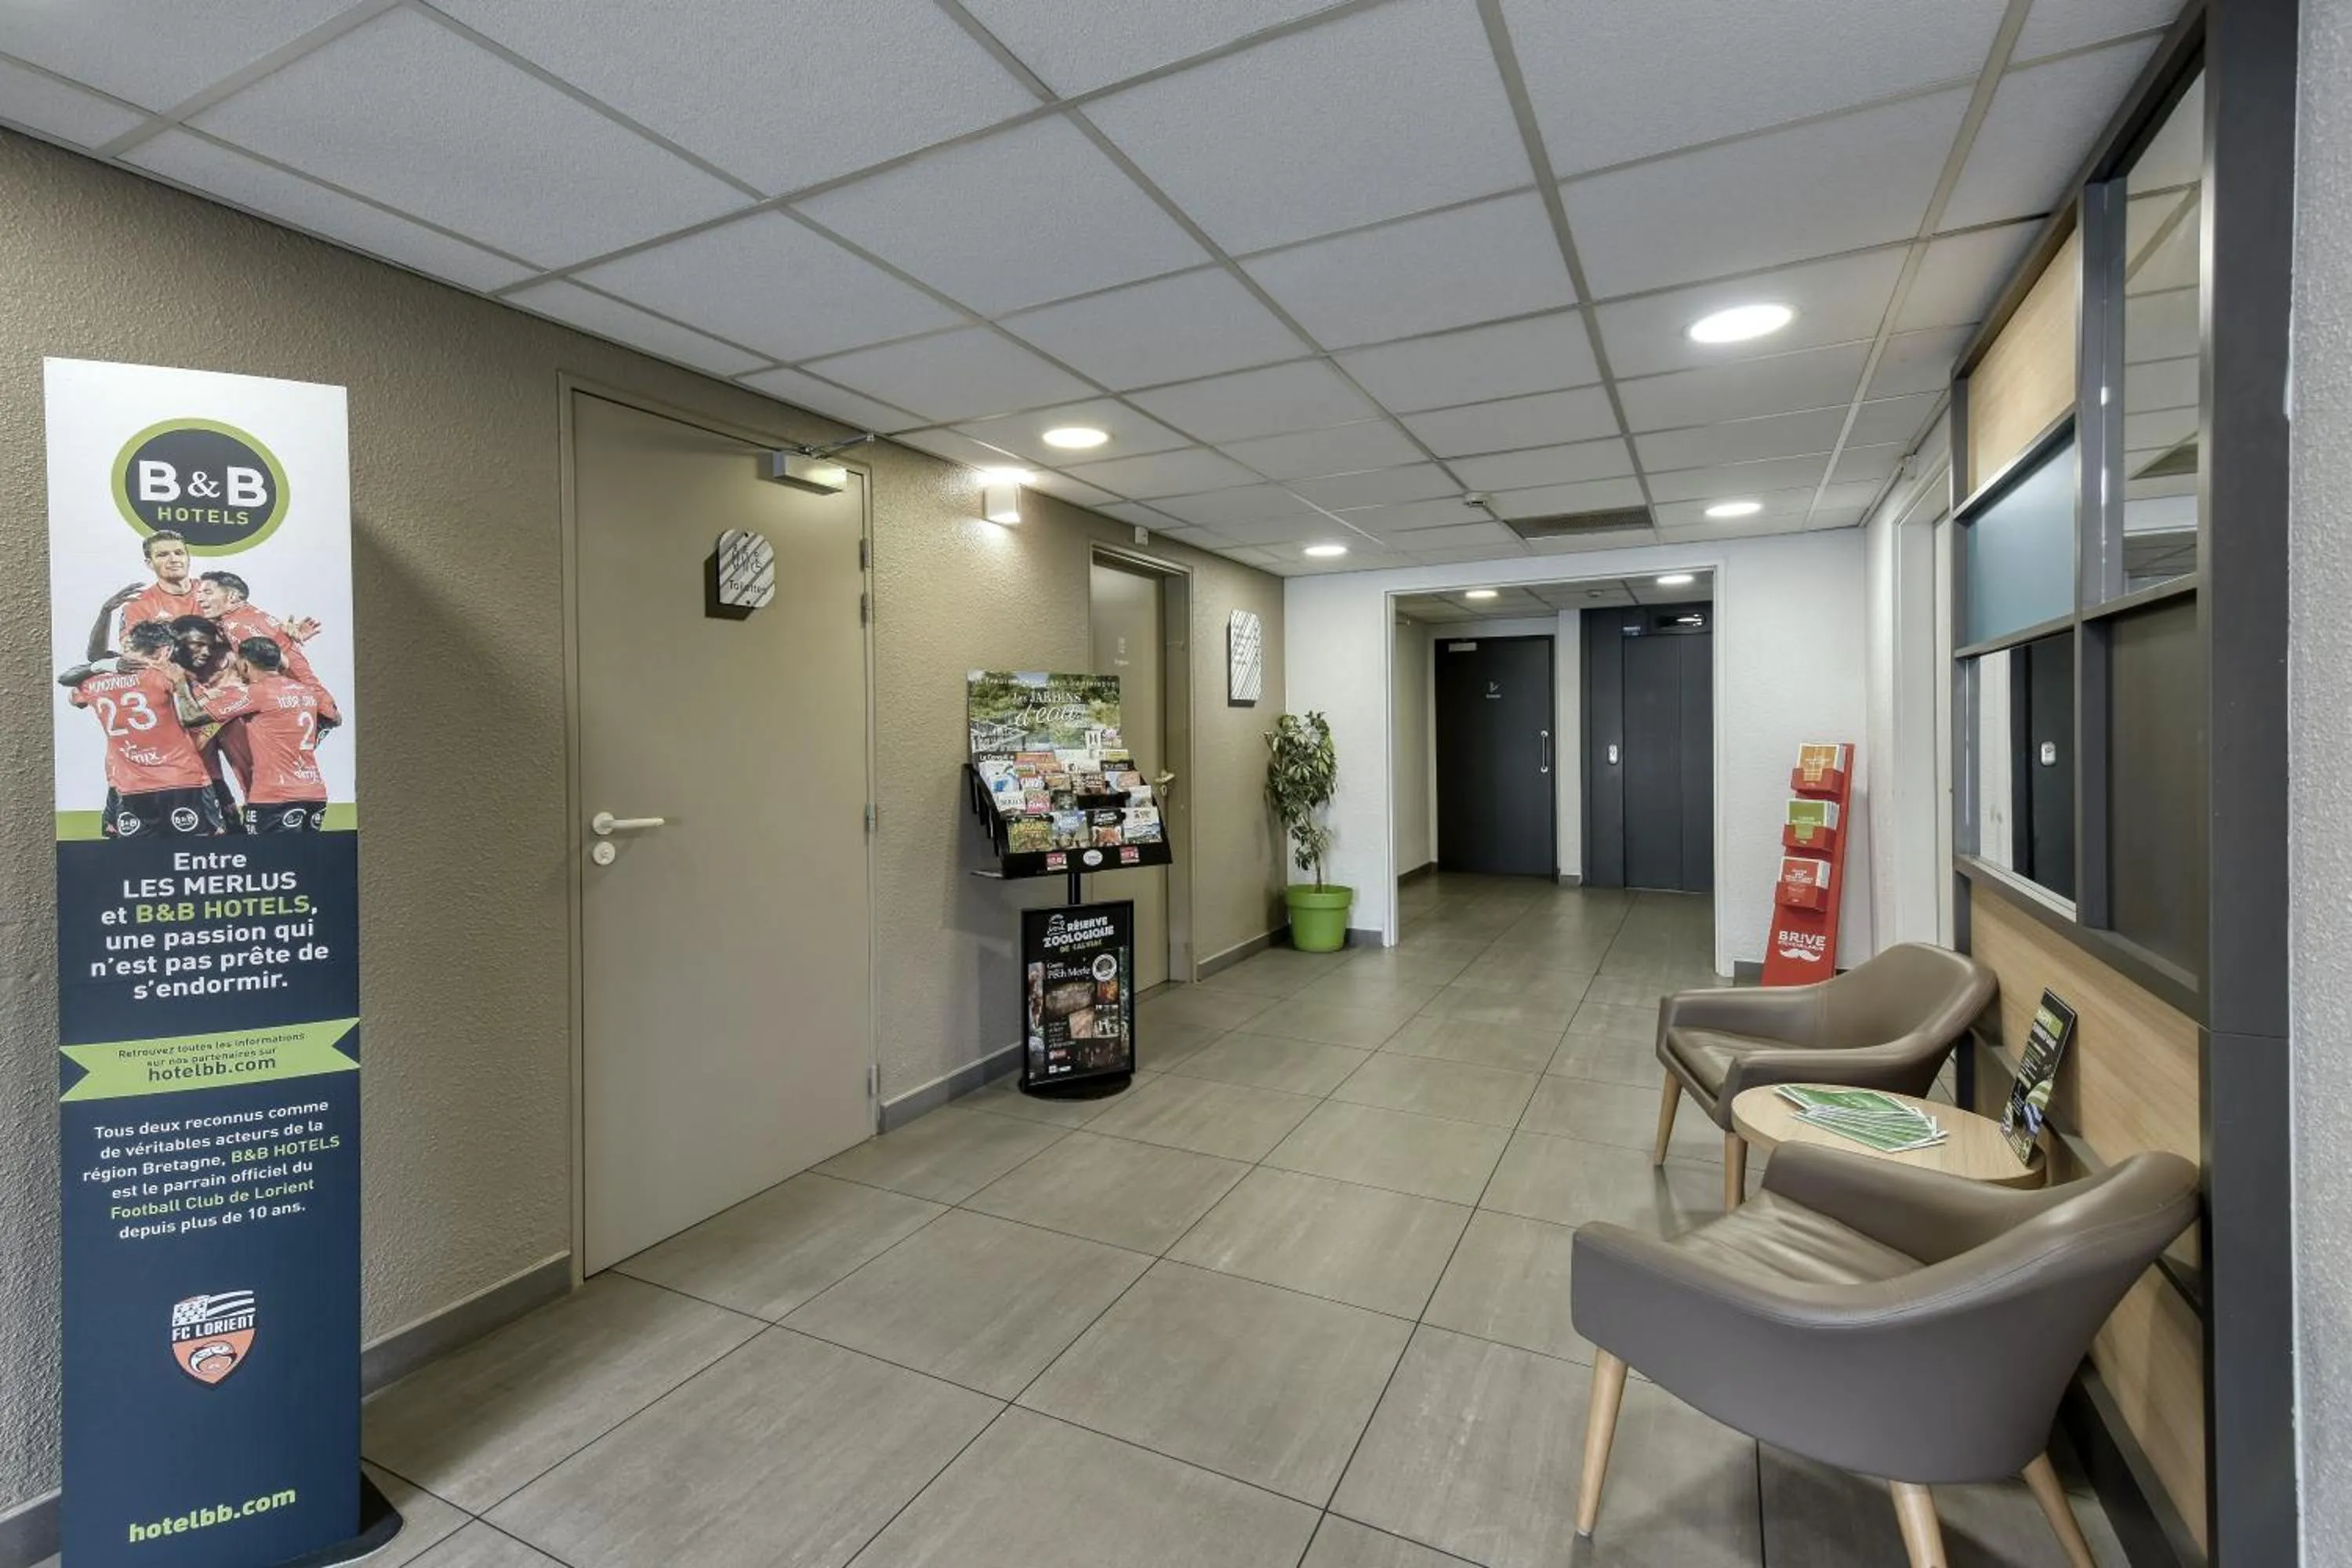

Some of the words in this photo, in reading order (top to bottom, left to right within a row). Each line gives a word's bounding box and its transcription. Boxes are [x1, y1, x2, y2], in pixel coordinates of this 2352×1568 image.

[139, 460, 267, 507] B&B
[158, 506, 249, 525] HOTELS
[97, 691, 157, 736] 23
[297, 711, 314, 750] 2
[174, 852, 247, 871] Entre
[123, 877, 175, 898] LES
[184, 872, 297, 895] MERLUS
[101, 907, 127, 925] et
[136, 902, 195, 923] B&B
[205, 895, 318, 919] HOTELS,
[106, 931, 155, 950] une
[164, 925, 267, 951] passion
[275, 919, 314, 944] qui
[1043, 925, 1115, 948] ZOOLOGIQUE
[90, 956, 157, 977] n'est
[165, 953, 212, 975] pas
[220, 946, 291, 970] prête
[298, 943, 329, 960] de
[133, 971, 288, 1000] s'endormir.
[118, 1046, 175, 1058] Retrouvez
[178, 1044, 212, 1053] toutes
[234, 1033, 305, 1047] informations
[192, 1050, 256, 1063] partenaires
[148, 1058, 276, 1082] hotelbb.com
[95, 1126, 135, 1140] Tous
[140, 1120, 180, 1135] deux
[186, 1111, 264, 1131] reconnus
[269, 1100, 329, 1120] comme
[100, 1145, 122, 1160] de
[125, 1136, 211, 1156] véritables
[216, 1129, 279, 1146] acteurs
[284, 1123, 303, 1136] de
[308, 1120, 324, 1133] la
[83, 1166, 137, 1184] région
[143, 1156, 226, 1178] Bretagne,
[231, 1147, 269, 1163] B&B
[274, 1135, 340, 1157] HOTELS
[112, 1185, 137, 1200] est
[143, 1181, 158, 1196] le
[163, 1175, 226, 1196] parrain
[231, 1163, 288, 1183] officiel
[292, 1160, 314, 1174] du
[111, 1200, 181, 1220] Football
[186, 1194, 224, 1210] Club
[230, 1189, 250, 1203] de
[255, 1179, 314, 1200] Lorient
[119, 1221, 176, 1240] depuis
[181, 1216, 217, 1234] plus
[222, 1211, 242, 1225] de
[249, 1207, 267, 1221] 10
[271, 1202, 306, 1218] ans.
[172, 1326, 191, 1342] FC
[196, 1313, 255, 1338] LORIENT
[129, 1487, 296, 1543] hotelbb.com
